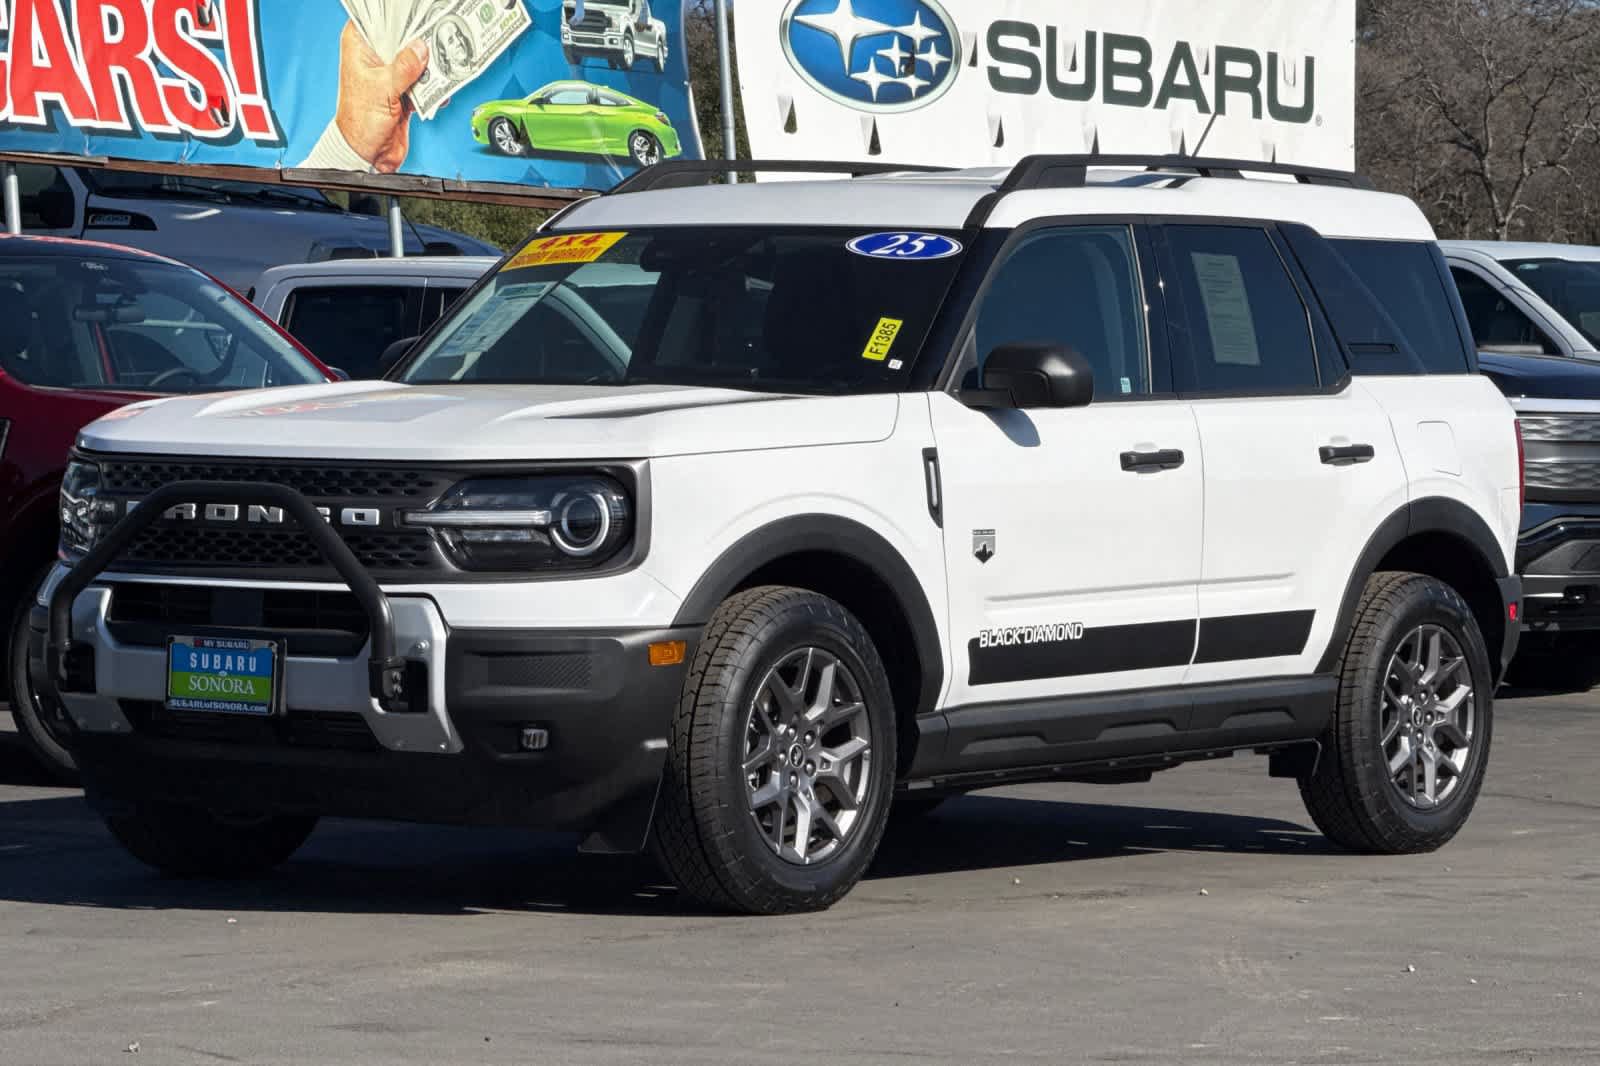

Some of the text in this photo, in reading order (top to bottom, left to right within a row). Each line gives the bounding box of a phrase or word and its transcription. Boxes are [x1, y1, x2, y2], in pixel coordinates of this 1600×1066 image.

[0, 0, 279, 141] ARS!
[986, 20, 1315, 125] SUBARU
[869, 234, 938, 256] 25
[869, 322, 897, 355] F1385
[126, 500, 380, 526] RONO
[979, 622, 1084, 648] BLACK DIAMOND
[190, 653, 256, 672] SUBARU
[188, 676, 254, 695] SONORA
